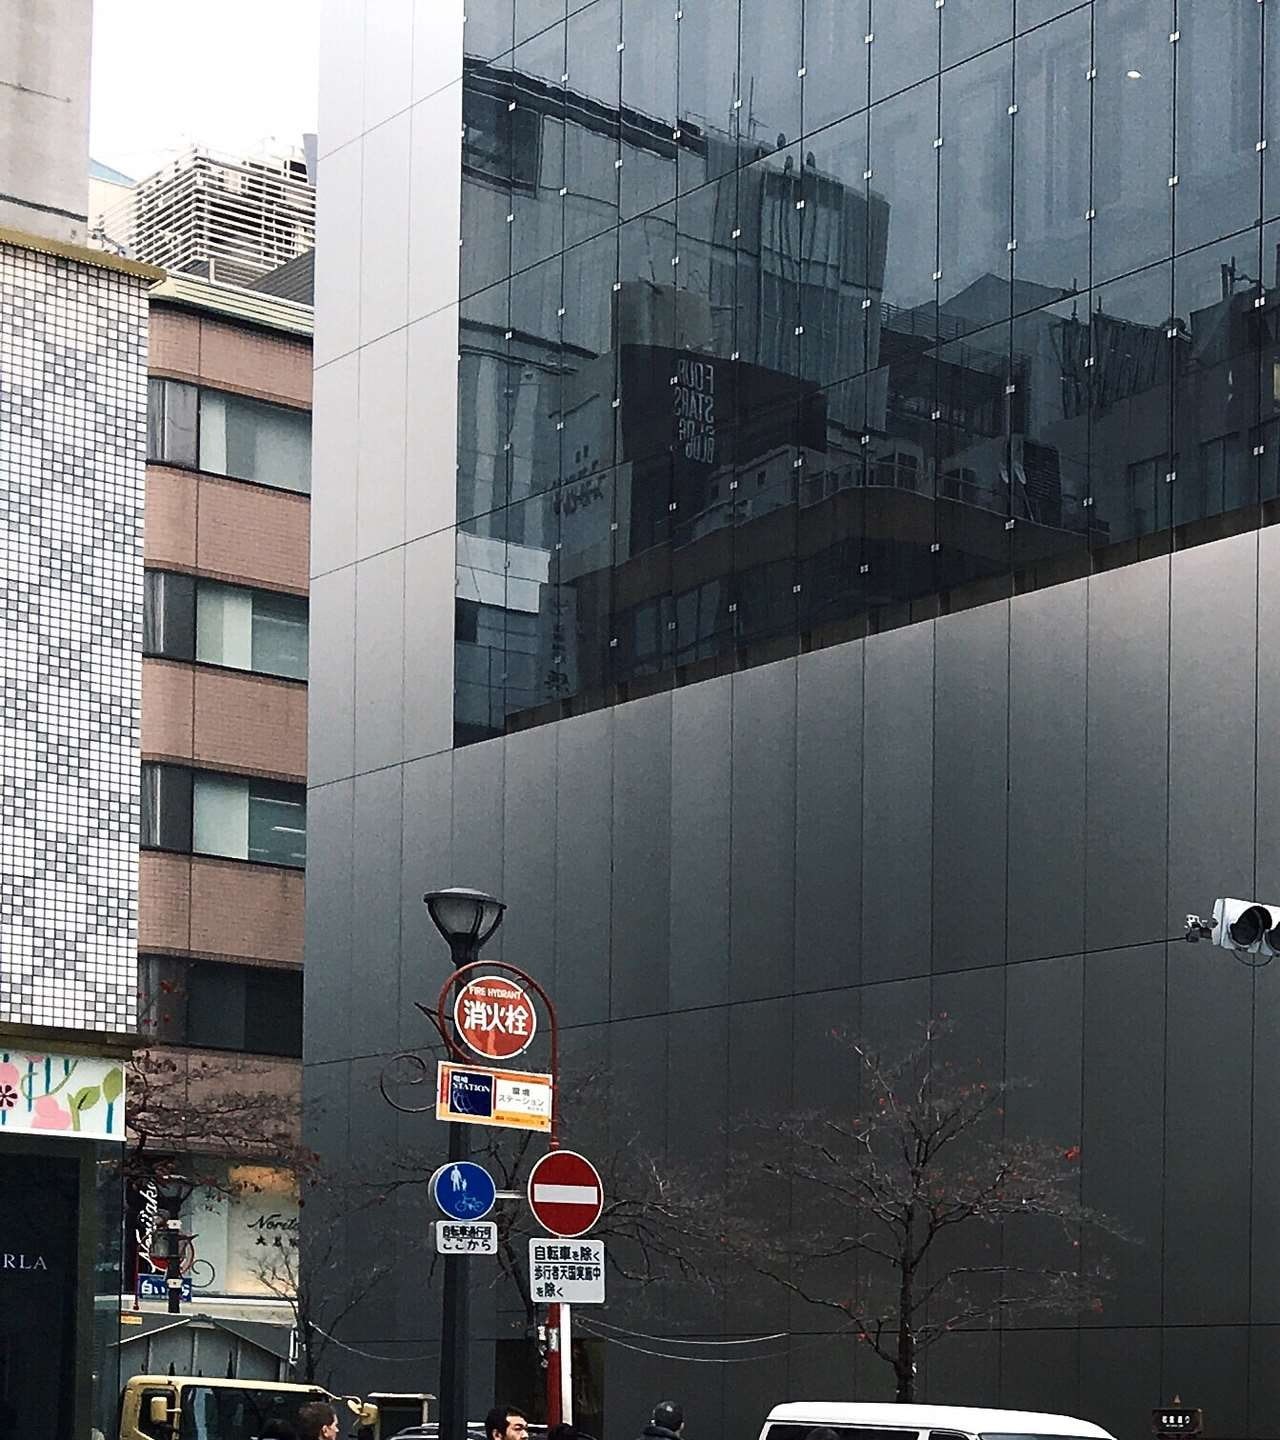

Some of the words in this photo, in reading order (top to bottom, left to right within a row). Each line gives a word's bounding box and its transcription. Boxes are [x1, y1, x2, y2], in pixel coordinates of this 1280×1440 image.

[469, 986, 486, 996] FIRE
[487, 988, 522, 1000] HYDRANT
[463, 999, 529, 1036] 消火栓
[452, 1082, 490, 1093] STATION
[498, 1094, 545, 1107] ステーション
[443, 1239, 491, 1251] ここから
[534, 1246, 600, 1262] 自転車を除く
[534, 1265, 601, 1281] 歩行者天国実施中
[141, 1279, 191, 1296] 白いら
[536, 1282, 563, 1297] を除く
